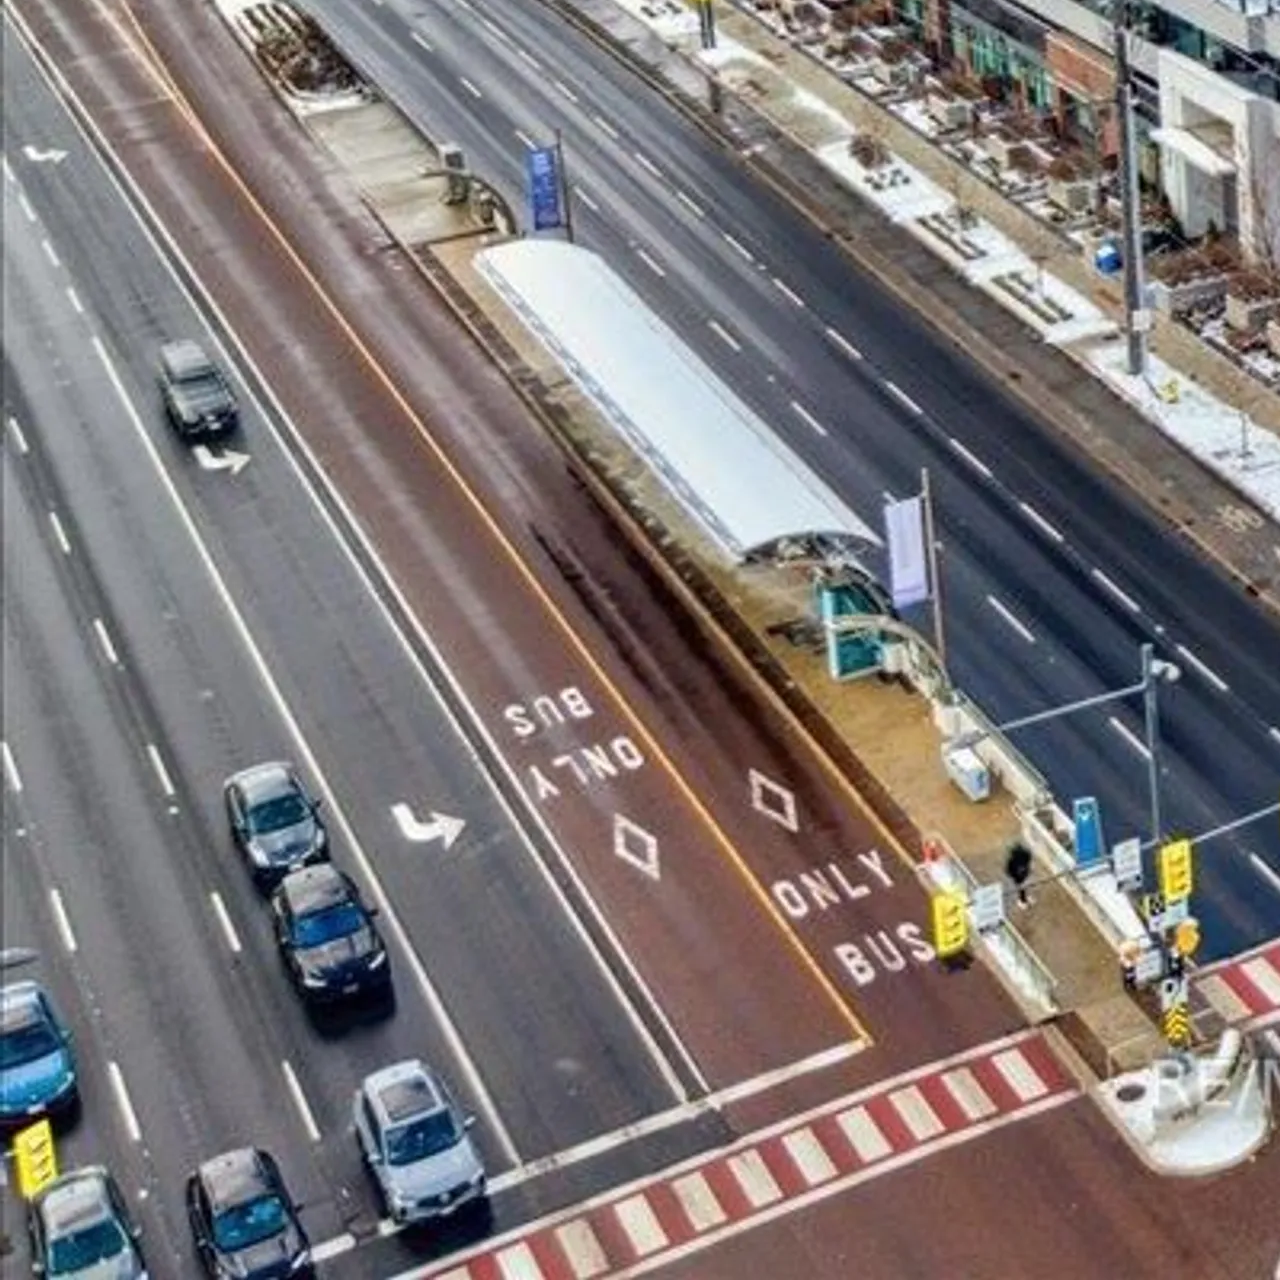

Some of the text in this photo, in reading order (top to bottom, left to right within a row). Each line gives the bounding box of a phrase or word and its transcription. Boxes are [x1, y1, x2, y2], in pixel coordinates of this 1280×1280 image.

[505, 686, 593, 737] BUS
[529, 735, 645, 799] ONLY
[771, 849, 895, 918] ONLY
[833, 922, 936, 987] BUS
